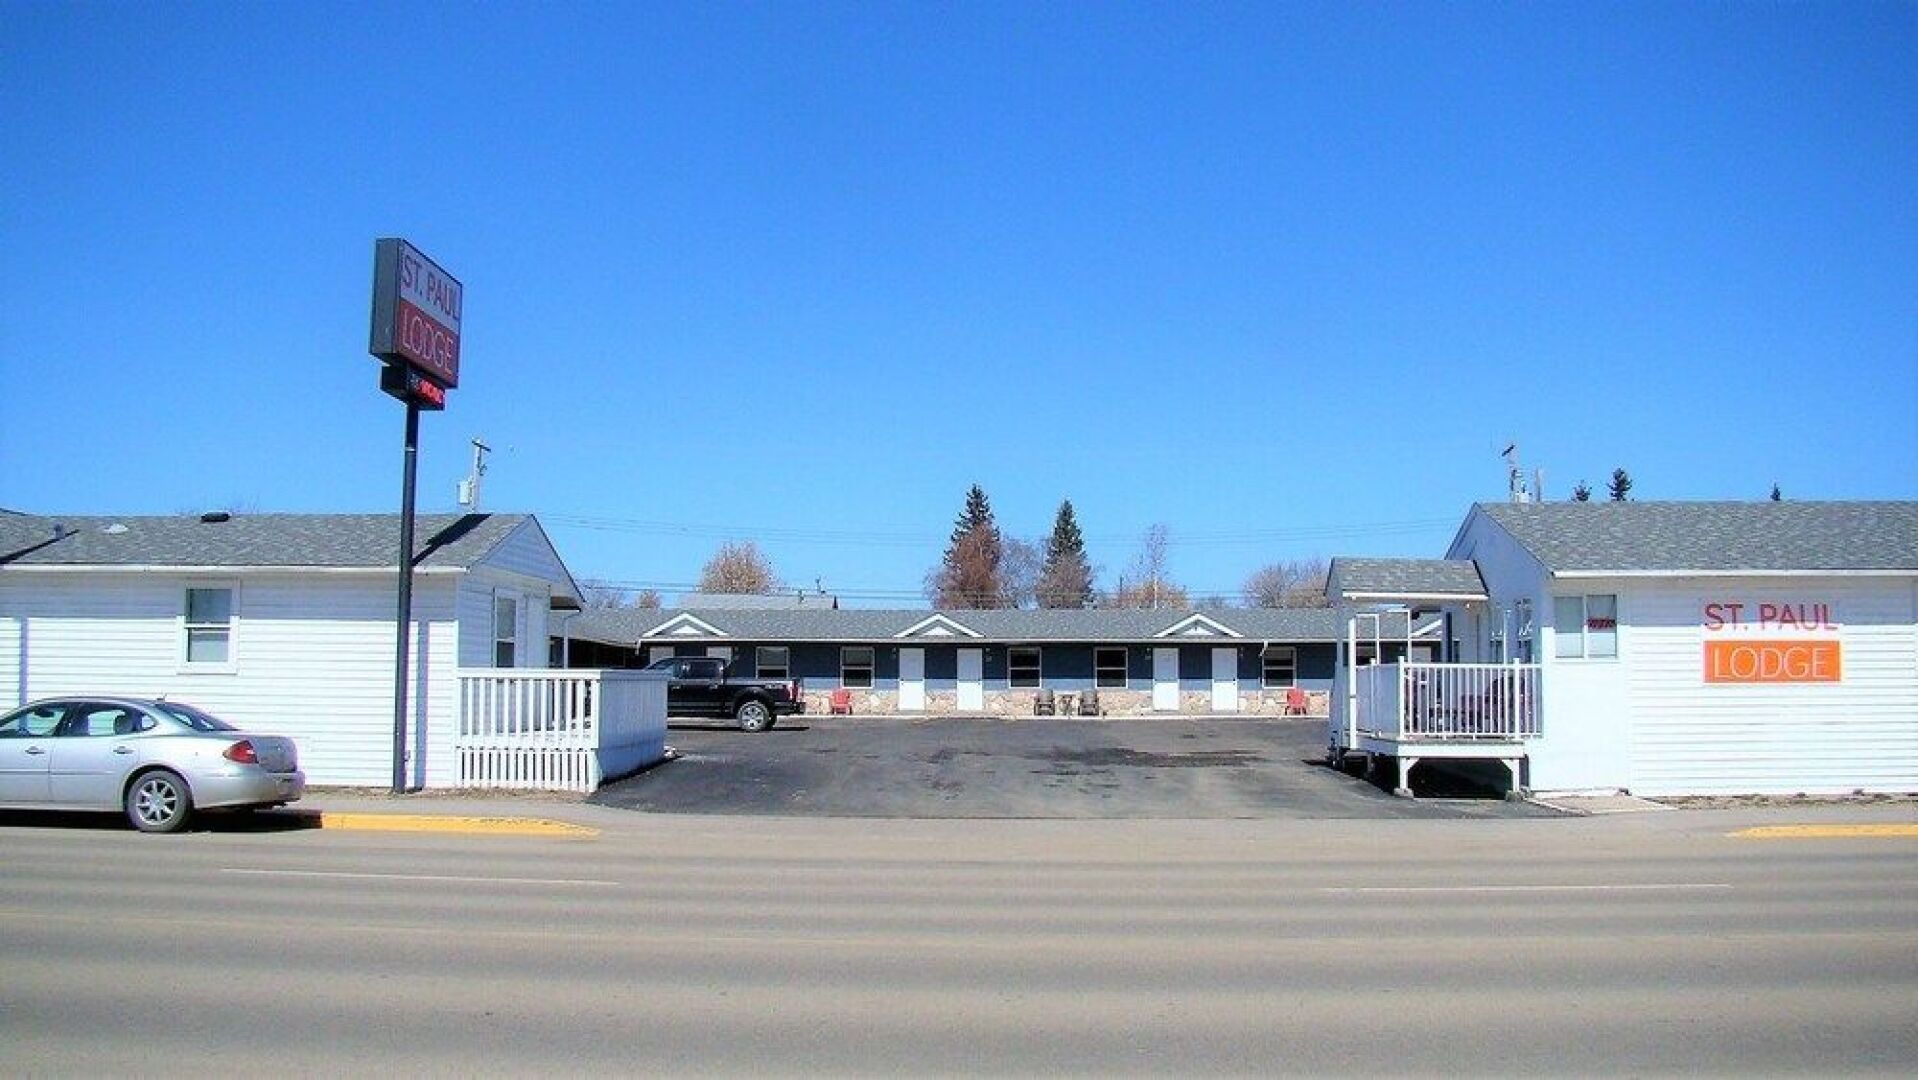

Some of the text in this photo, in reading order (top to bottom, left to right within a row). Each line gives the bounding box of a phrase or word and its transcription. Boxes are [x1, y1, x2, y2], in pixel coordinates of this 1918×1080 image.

[402, 254, 459, 320] ST. PAUL
[402, 308, 454, 377] LODGE
[1704, 603, 1838, 631] ST. PAUL
[1713, 646, 1830, 679] LODGE
